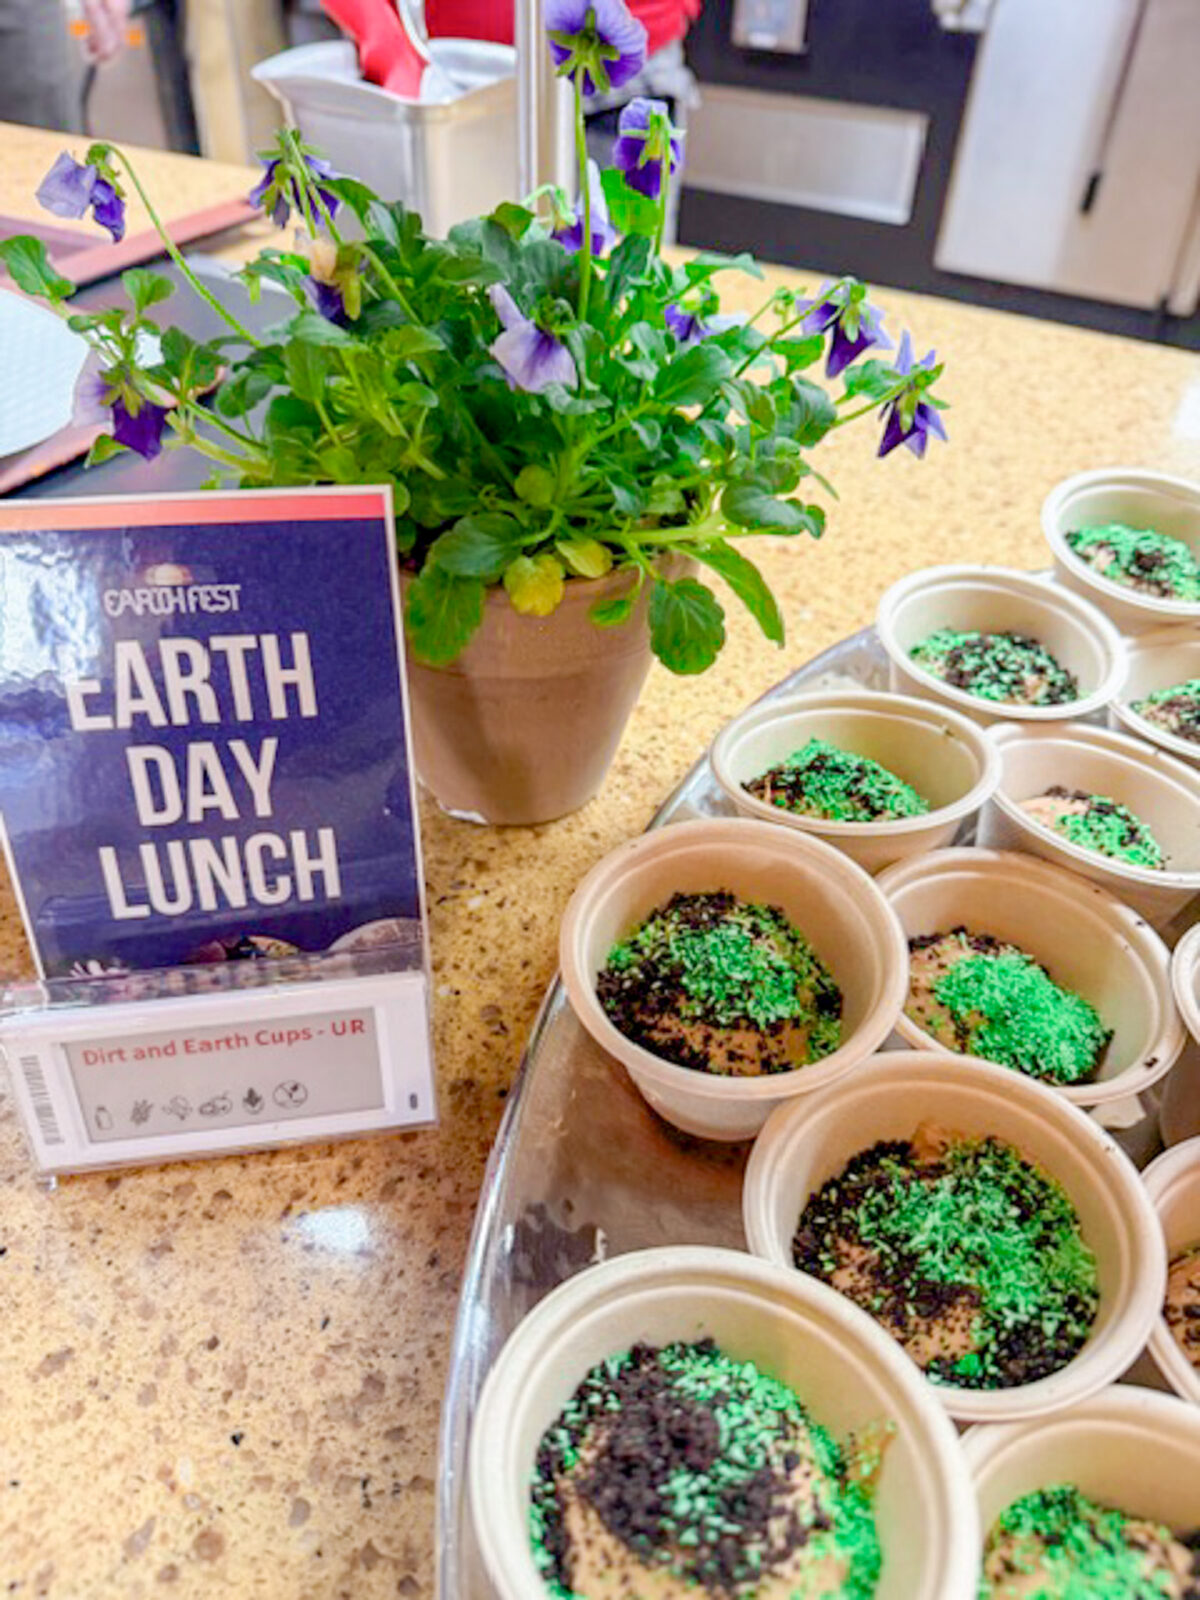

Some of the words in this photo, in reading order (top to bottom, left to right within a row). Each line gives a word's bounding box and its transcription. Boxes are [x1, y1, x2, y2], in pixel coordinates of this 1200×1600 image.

[57, 634, 318, 731] EARTH
[126, 737, 278, 826] DAY
[99, 828, 341, 919] LUNCH
[82, 1047, 127, 1066] Dirt
[133, 1041, 177, 1061] and
[184, 1032, 248, 1054] Earth
[255, 1027, 313, 1046] Cups
[330, 1018, 366, 1036] UR
